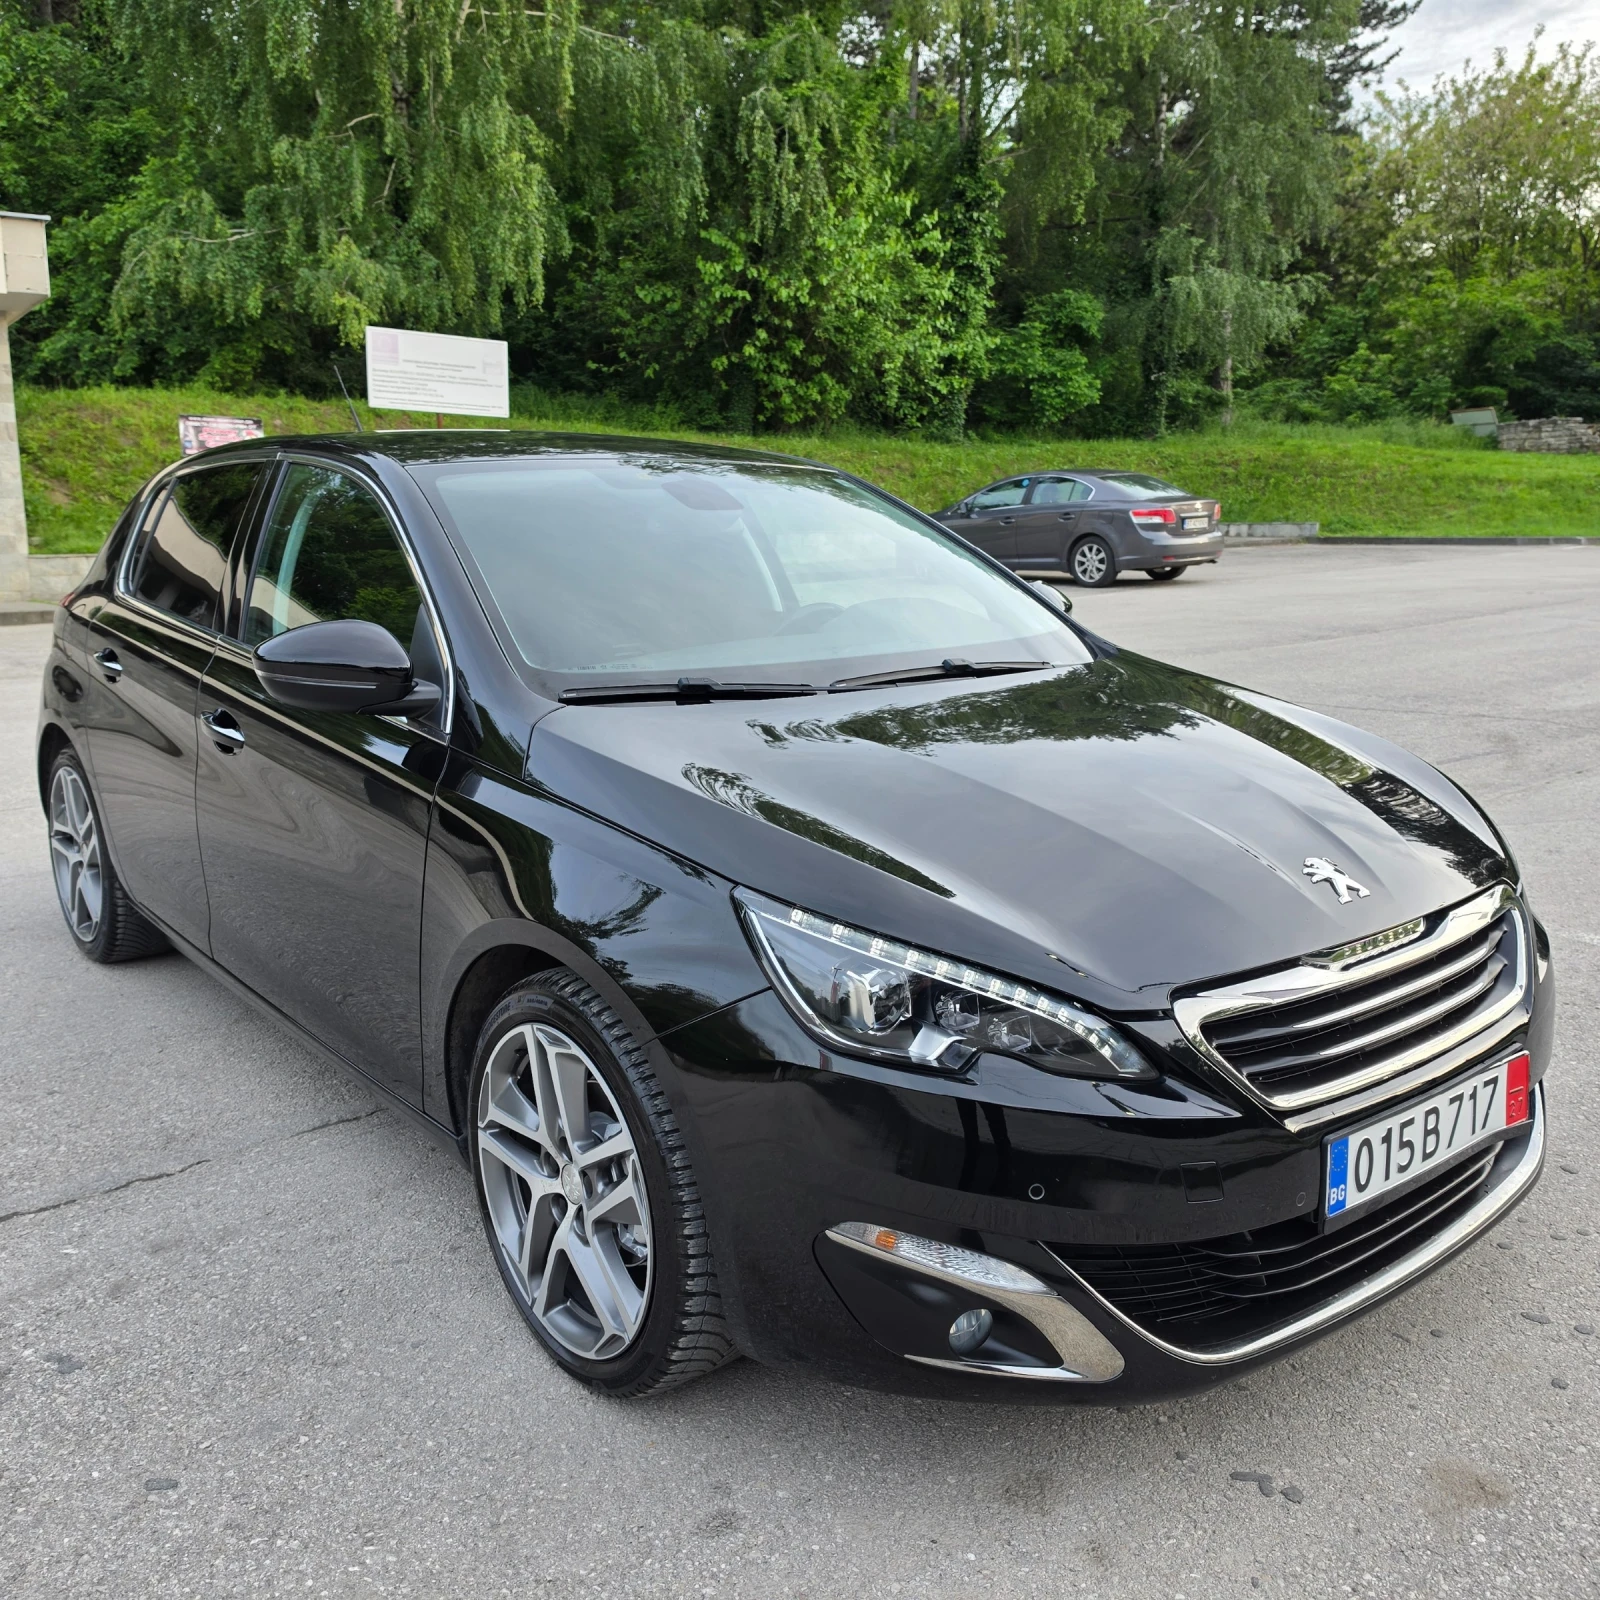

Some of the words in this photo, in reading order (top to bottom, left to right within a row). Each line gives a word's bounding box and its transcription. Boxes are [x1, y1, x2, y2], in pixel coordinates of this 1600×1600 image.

[1343, 924, 1414, 958] PEUGEOT
[481, 1001, 512, 1043] GESTONE
[1354, 1073, 1499, 1194] 015B717
[1329, 1184, 1346, 1206] BG
